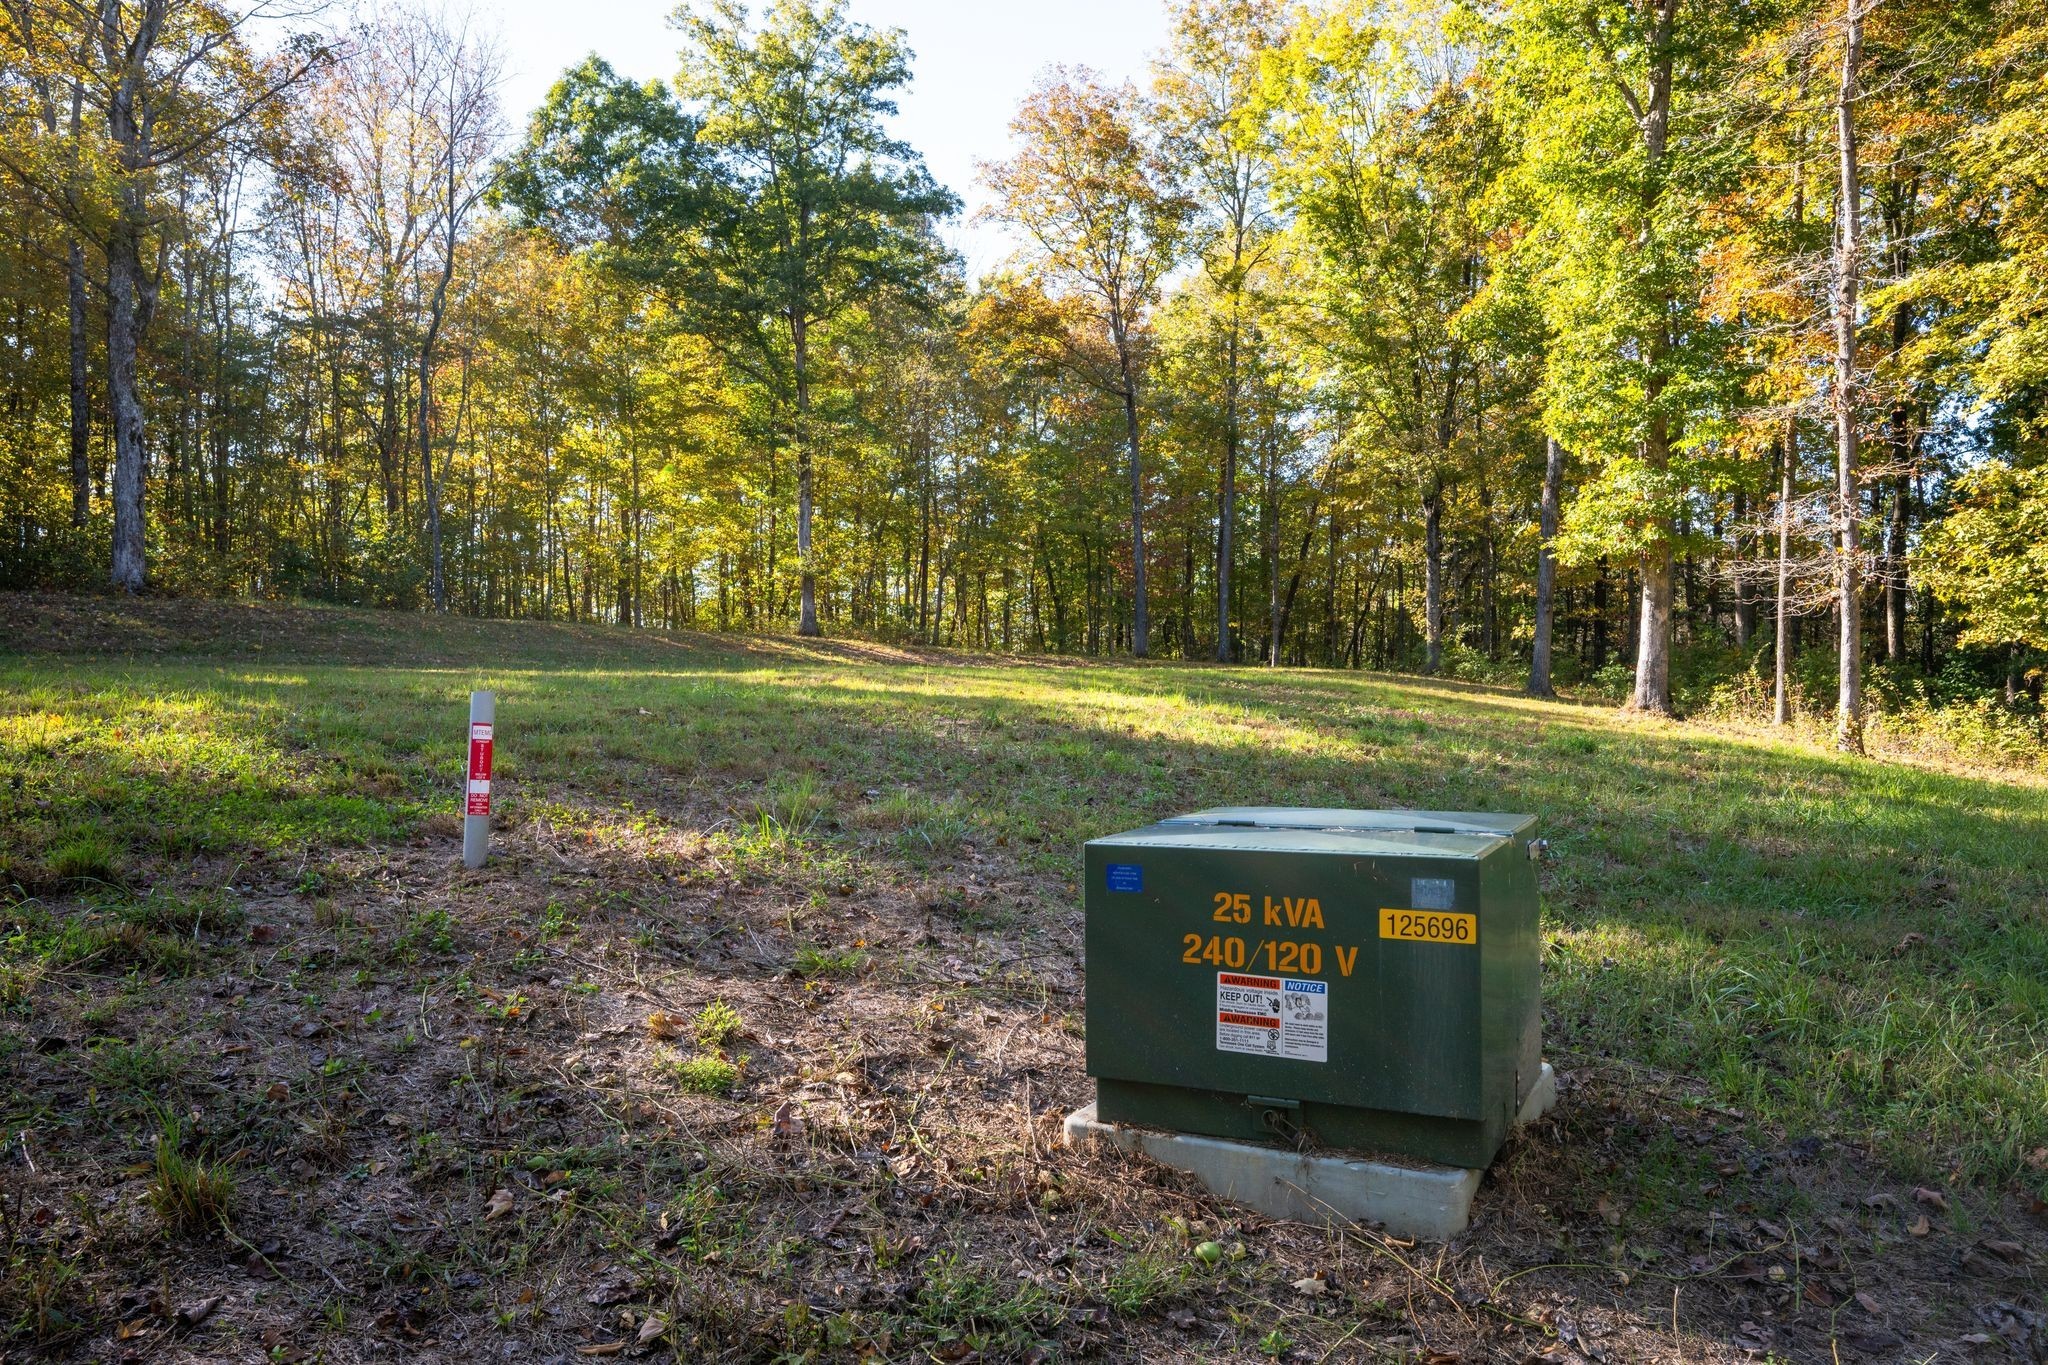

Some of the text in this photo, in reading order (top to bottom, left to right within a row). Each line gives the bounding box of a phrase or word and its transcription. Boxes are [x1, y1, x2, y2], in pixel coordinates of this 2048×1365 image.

[1213, 892, 1325, 929] 25 kVA
[1387, 914, 1468, 940] 125696
[1182, 933, 1359, 977] 240/120 V
[1231, 976, 1277, 989] WARNING
[1287, 981, 1323, 993] NOTICE
[1220, 991, 1241, 1001] KEEP
[1243, 993, 1263, 1004] OUT!
[1231, 1014, 1276, 1027] WARNING
